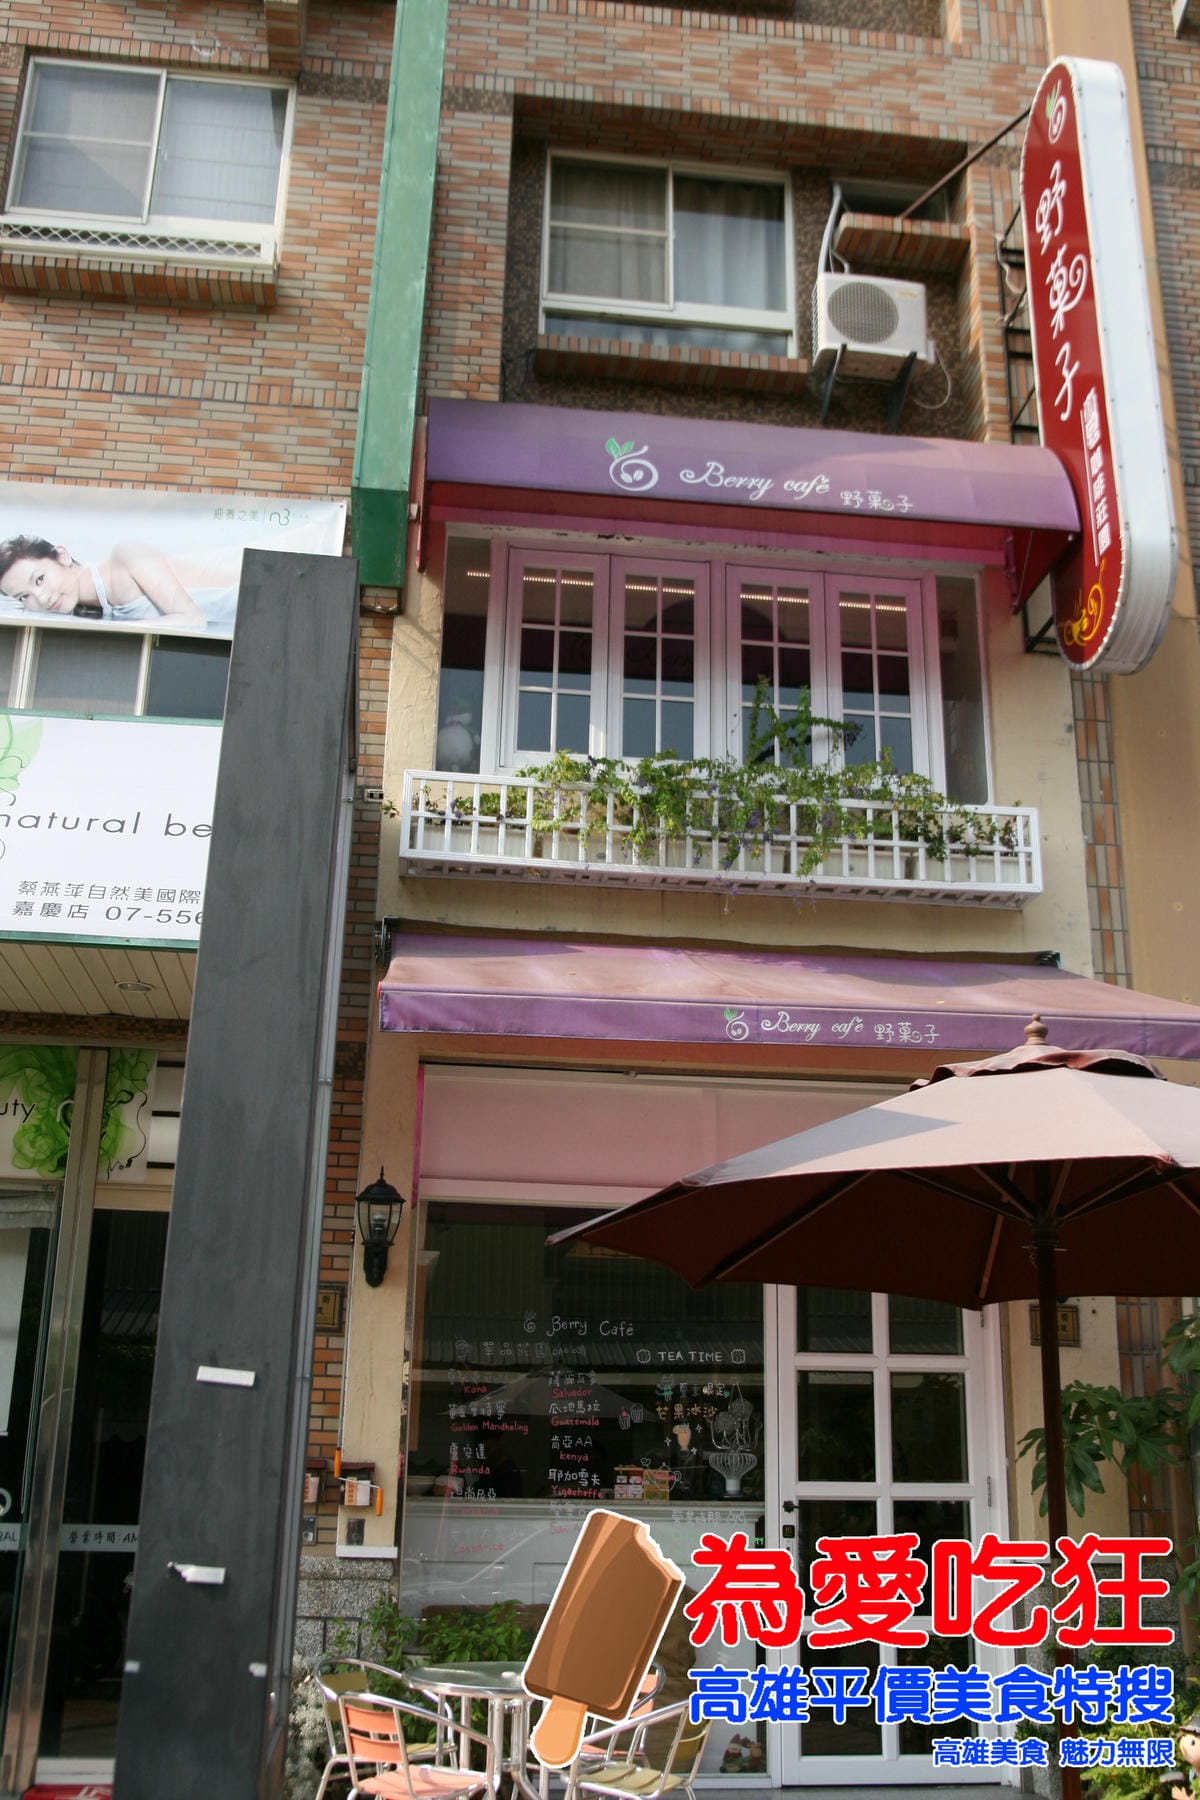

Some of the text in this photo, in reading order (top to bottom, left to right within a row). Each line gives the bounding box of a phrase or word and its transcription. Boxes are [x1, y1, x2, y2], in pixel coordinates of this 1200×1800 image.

[679, 461, 774, 500] Berry
[783, 474, 830, 500] café
[0, 812, 141, 834] natural
[11, 900, 90, 920] 嘉慶店
[761, 1011, 821, 1041] Berry
[831, 1016, 864, 1040] café
[546, 1315, 634, 1336] Berry Café
[658, 1351, 723, 1362] TEA TIME
[656, 1401, 719, 1421] 芒果冰沙
[548, 1468, 600, 1487] 耶加雪夫
